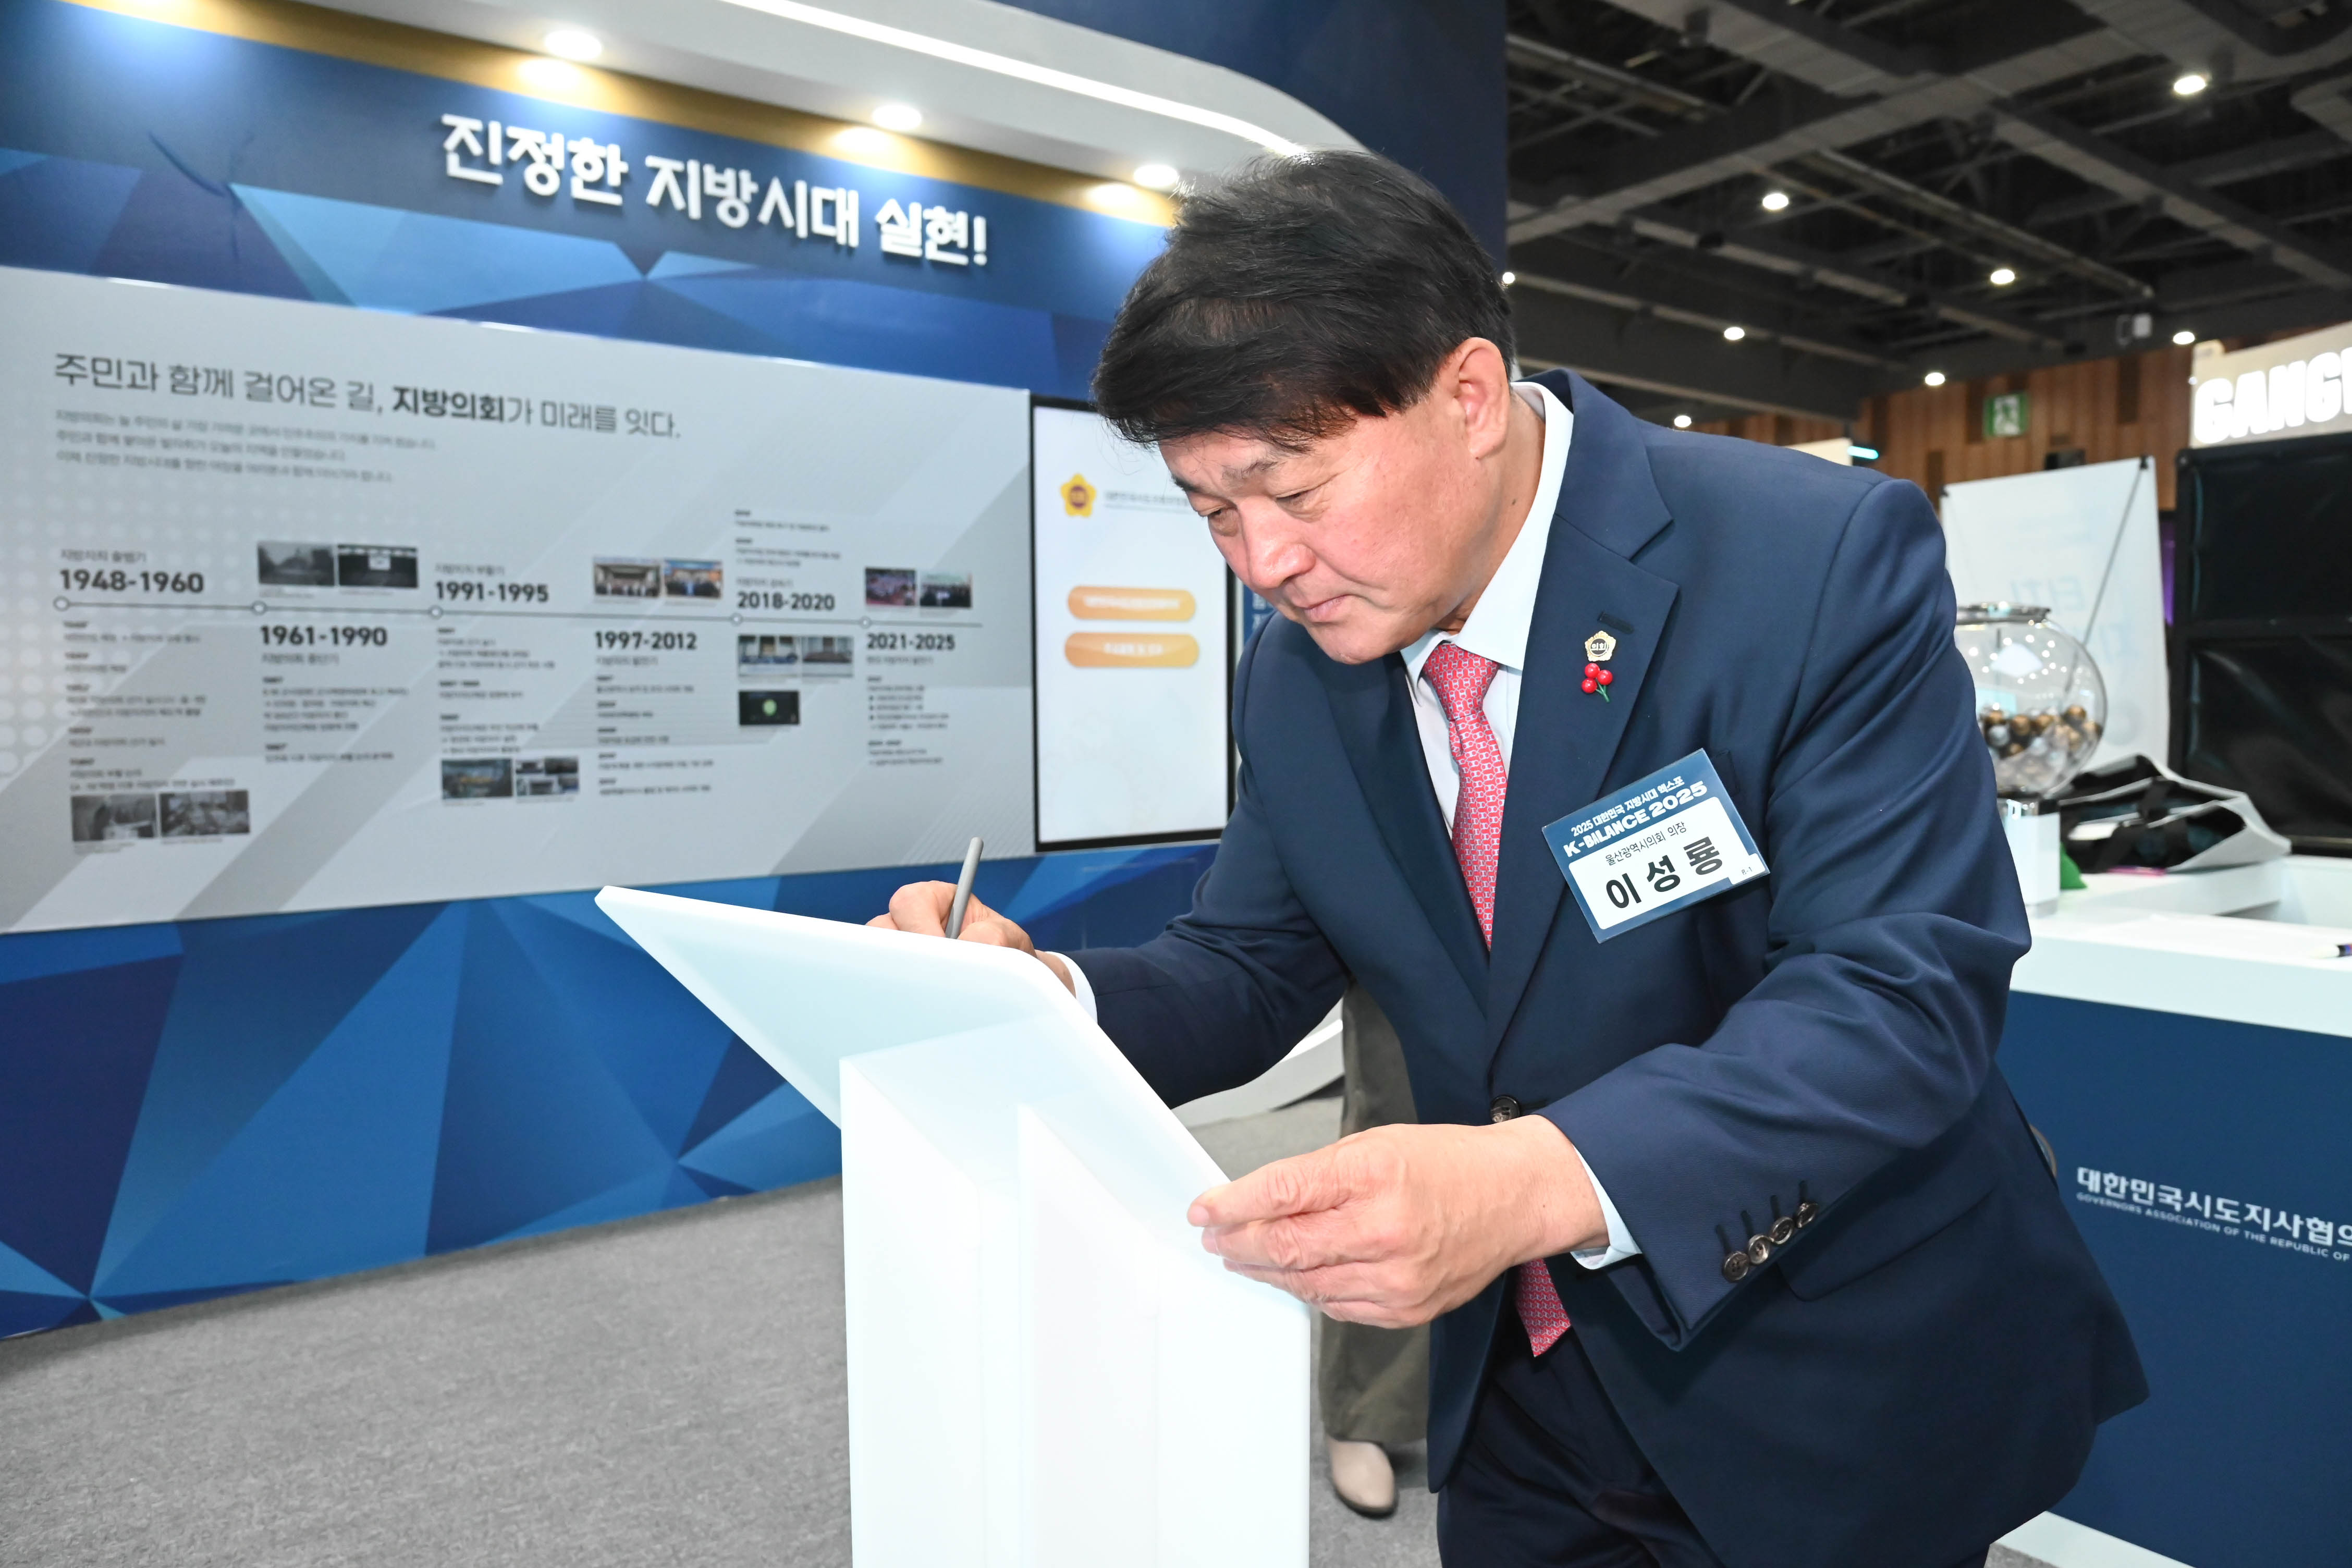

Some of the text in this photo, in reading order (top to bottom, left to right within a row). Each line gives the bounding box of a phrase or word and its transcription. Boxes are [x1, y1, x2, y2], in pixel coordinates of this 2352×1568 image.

[442, 114, 988, 265] 진정한 지방시대 실현!
[55, 353, 681, 438] 주민과 함께 걸어온 길, 지방의회가 미래를 잇다.
[60, 569, 205, 593] 1948-1960
[435, 580, 549, 603] 1991-1995
[737, 591, 835, 611] 2018-2020
[260, 625, 388, 646] 1961-1990
[595, 631, 697, 651] 1997-2012
[866, 633, 956, 651] 2021-2025
[1571, 776, 1685, 837] 2025 대한민국 지방시대 엑스포
[1648, 780, 1708, 818] 2025
[1605, 822, 1687, 866] 울산광역시의회 의장
[2076, 1192, 2350, 1262] GOVERNORS ASSOCIATION OF THE REPUBLIC OF
